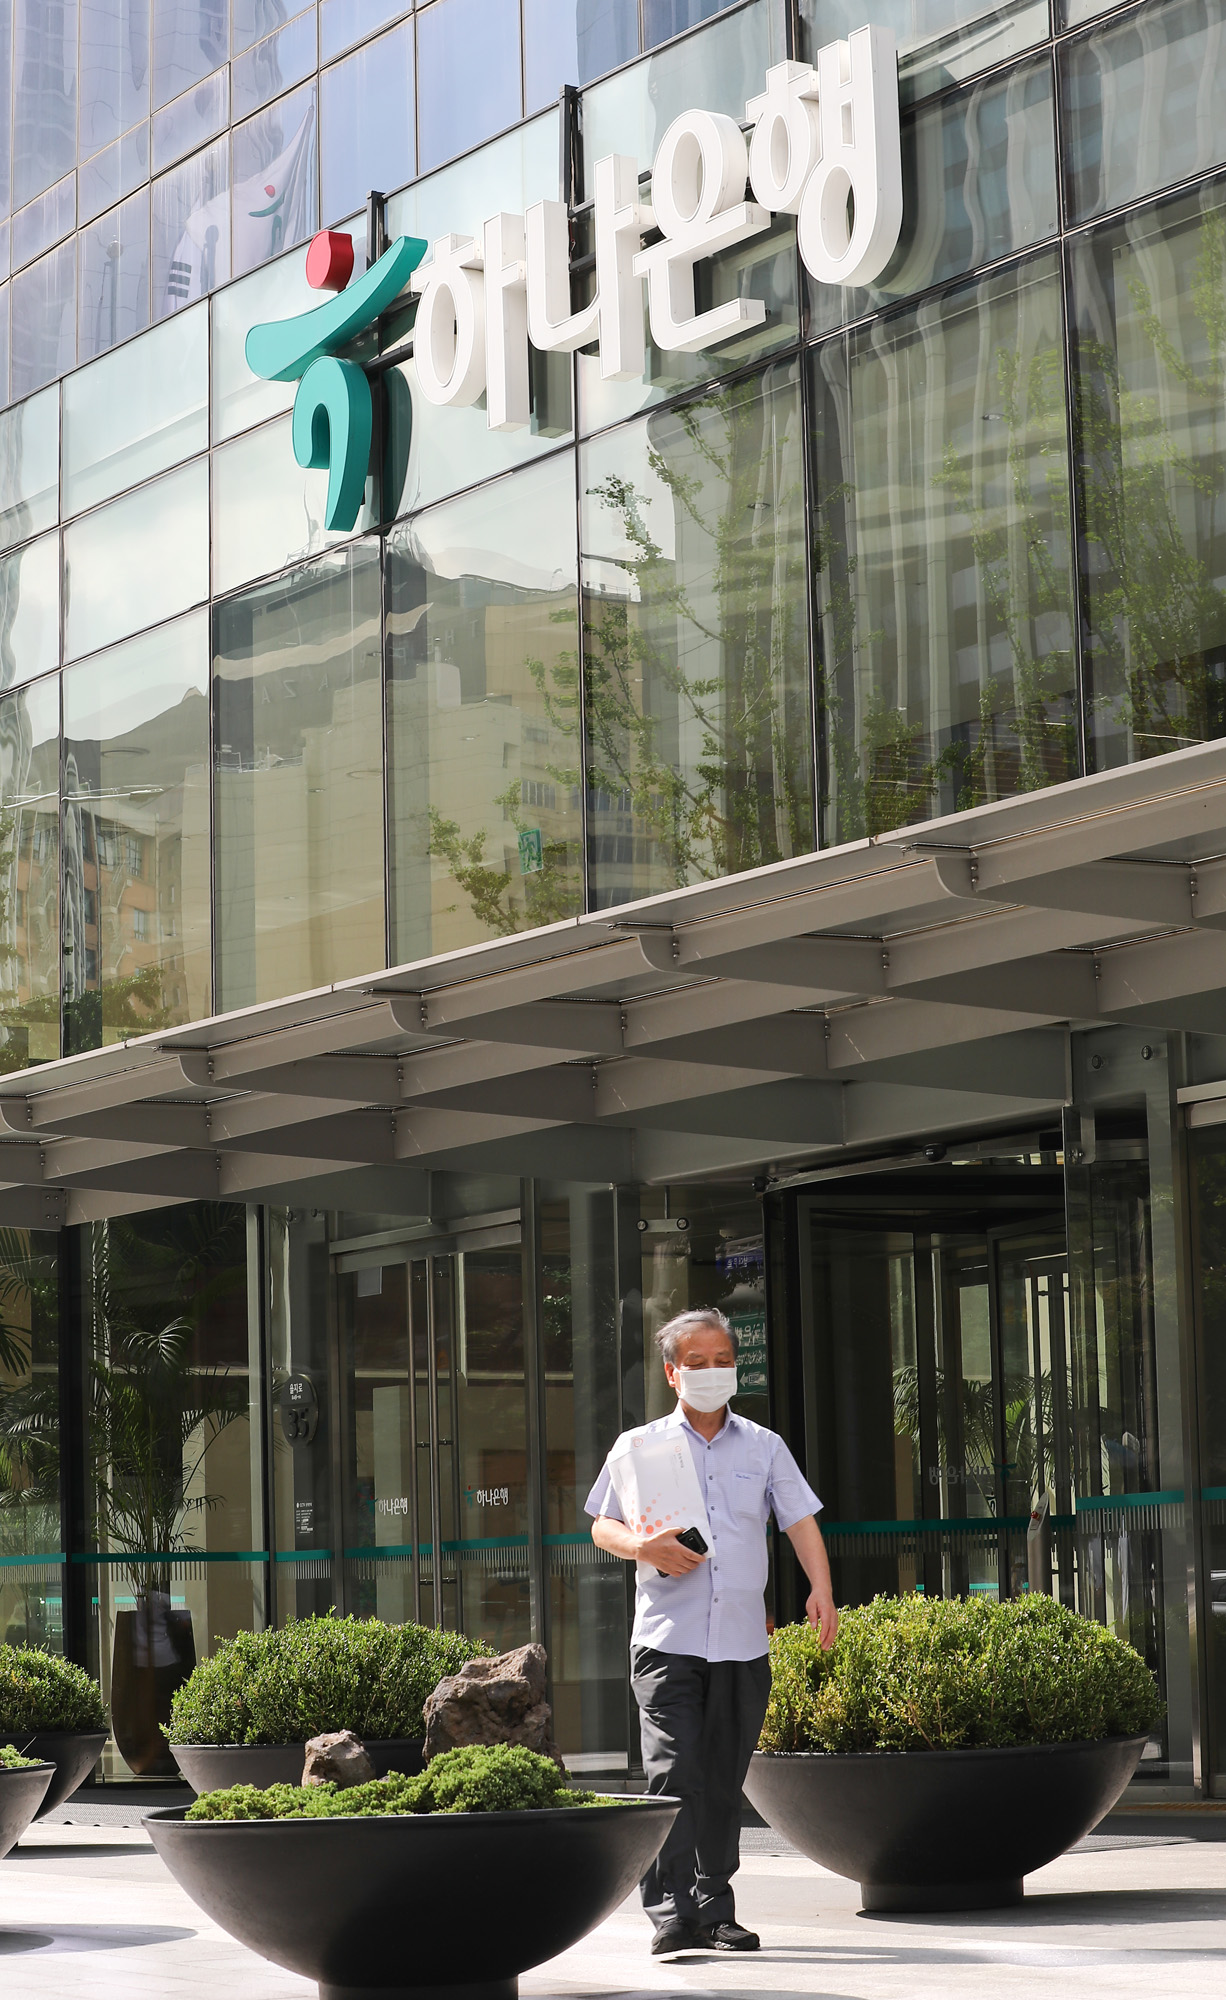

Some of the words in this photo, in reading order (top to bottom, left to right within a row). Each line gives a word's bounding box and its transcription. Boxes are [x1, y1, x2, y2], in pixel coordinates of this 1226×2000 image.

[411, 23, 903, 432] 하나은행
[289, 1383, 303, 1395] 을지로
[288, 1408, 309, 1439] 35
[378, 1497, 408, 1516] 하나은행
[476, 1487, 509, 1507] 하나은행
